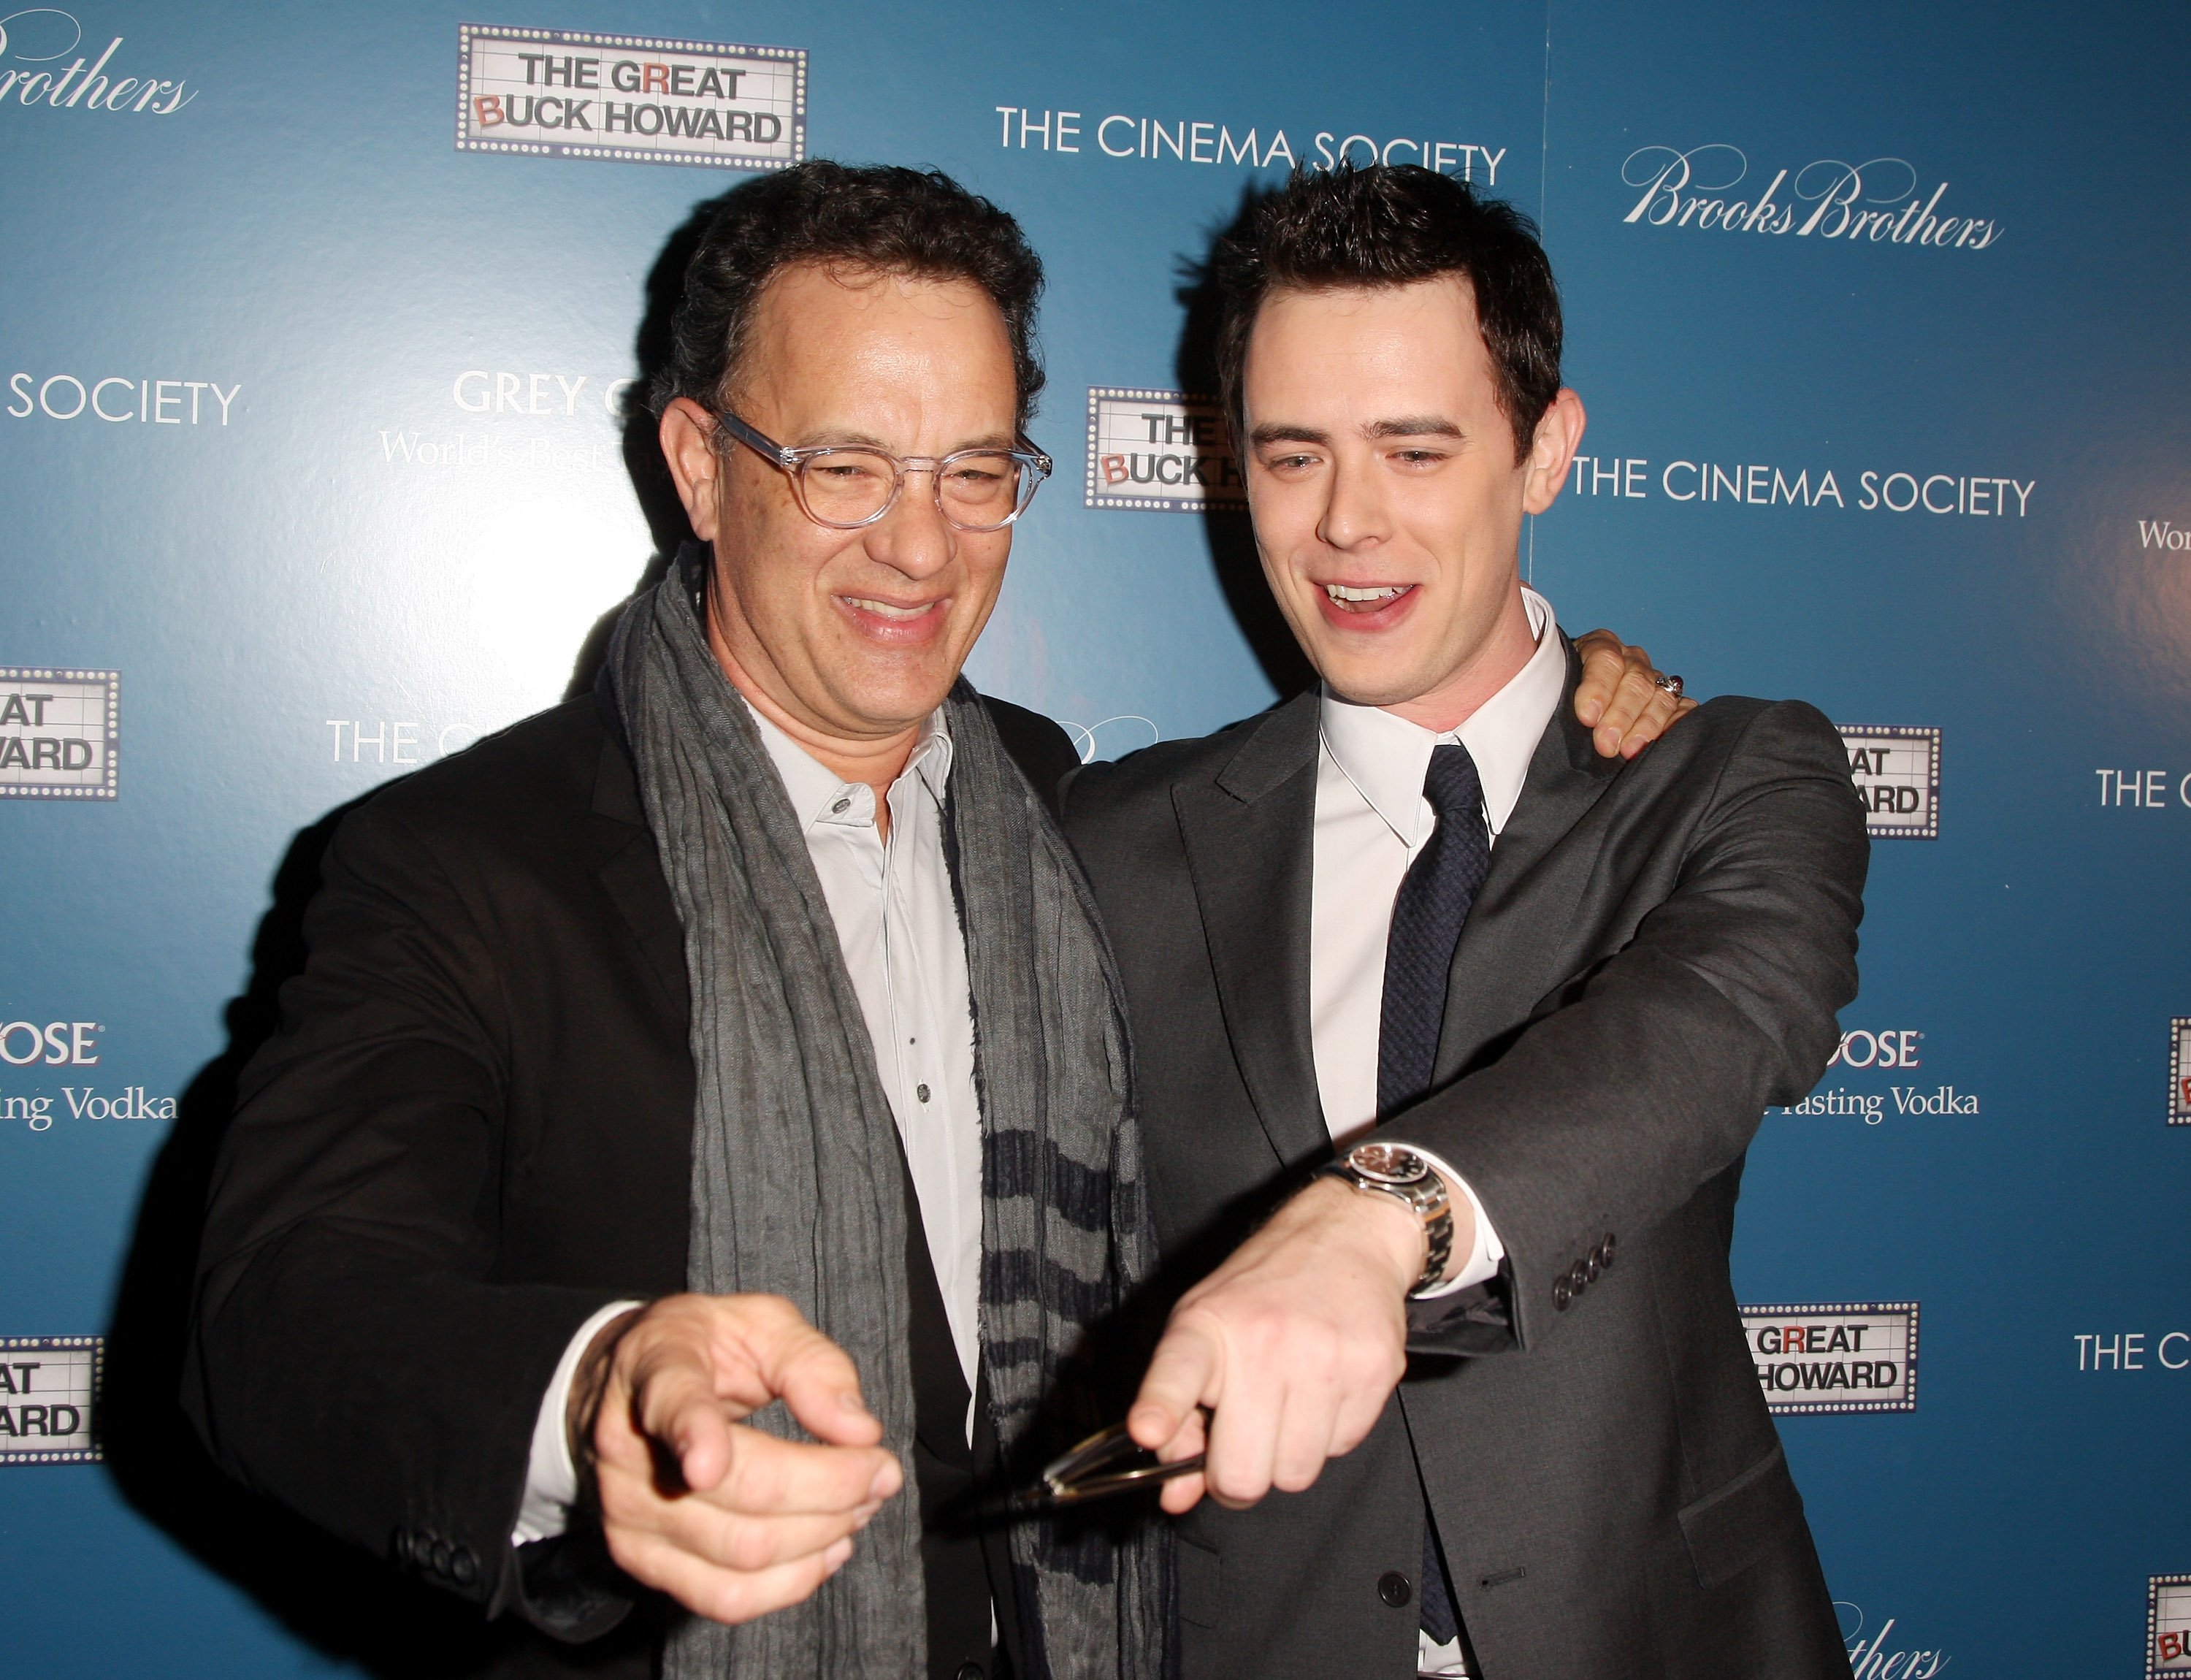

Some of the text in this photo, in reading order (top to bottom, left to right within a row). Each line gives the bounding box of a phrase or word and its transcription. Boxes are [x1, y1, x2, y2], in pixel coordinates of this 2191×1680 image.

[518, 53, 746, 99] THE GREAT
[474, 93, 781, 143] BUCK HOWARD
[995, 107, 1507, 186] THE CINEMA SOCIETY
[1621, 144, 2005, 250] Brooks Brothers
[7, 373, 242, 425] SOCIETY
[453, 370, 586, 416] GREY
[1142, 413, 1216, 446] THE
[379, 431, 516, 466] World's
[529, 438, 604, 471] Best
[1101, 453, 1209, 487] BUCK
[1572, 457, 2036, 517] THE CINEMA SOCIETY
[0, 736, 93, 771] ARD
[326, 720, 418, 764] THE
[2095, 769, 2167, 807] THE
[0, 1021, 99, 1065] OSE
[61, 1086, 179, 1120] Vodka
[1890, 1085, 1979, 1115] Vodka
[1756, 1324, 1868, 1355] GREAT
[2073, 1333, 2145, 1371] THE
[1754, 1360, 1897, 1391] HOWARD
